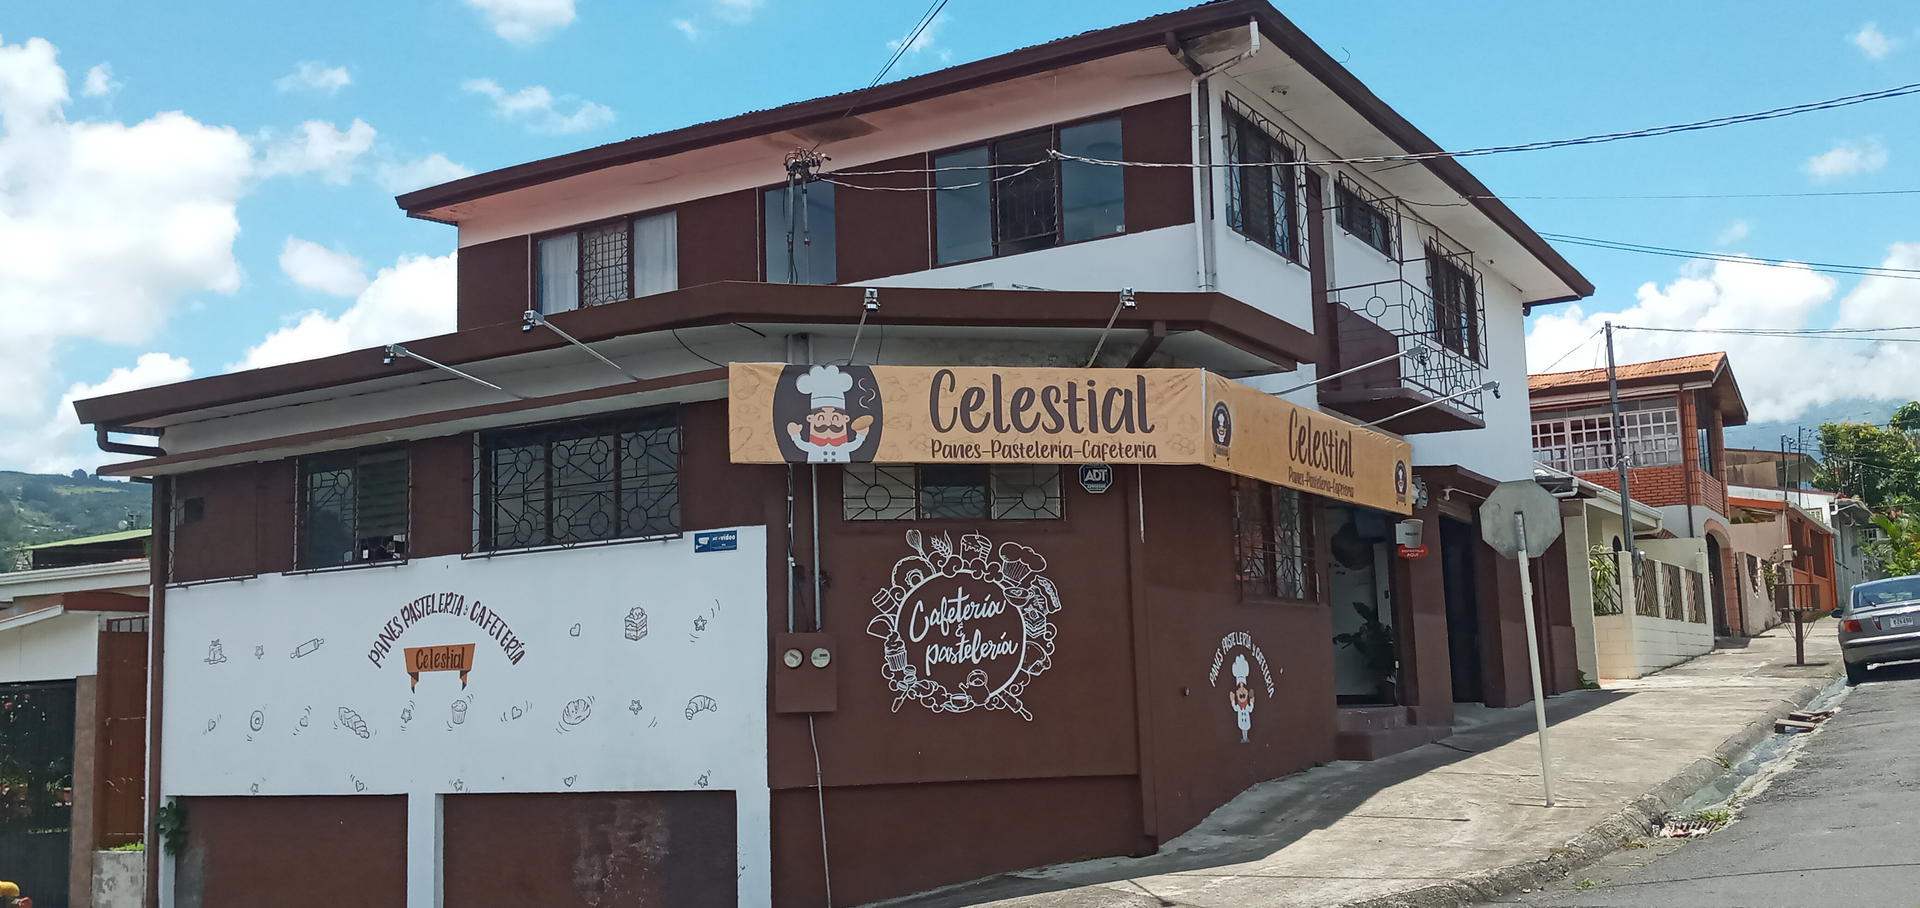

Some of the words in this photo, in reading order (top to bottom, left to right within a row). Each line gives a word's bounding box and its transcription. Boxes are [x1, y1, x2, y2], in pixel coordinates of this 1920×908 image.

[930, 368, 1155, 435] Celestial
[1288, 407, 1354, 478] Celestial
[1084, 469, 1107, 481] ADT
[367, 615, 404, 669] PANES
[469, 600, 526, 665] CAFETERÍA
[909, 586, 1006, 643] Cafetería
[415, 646, 465, 670] Celestial
